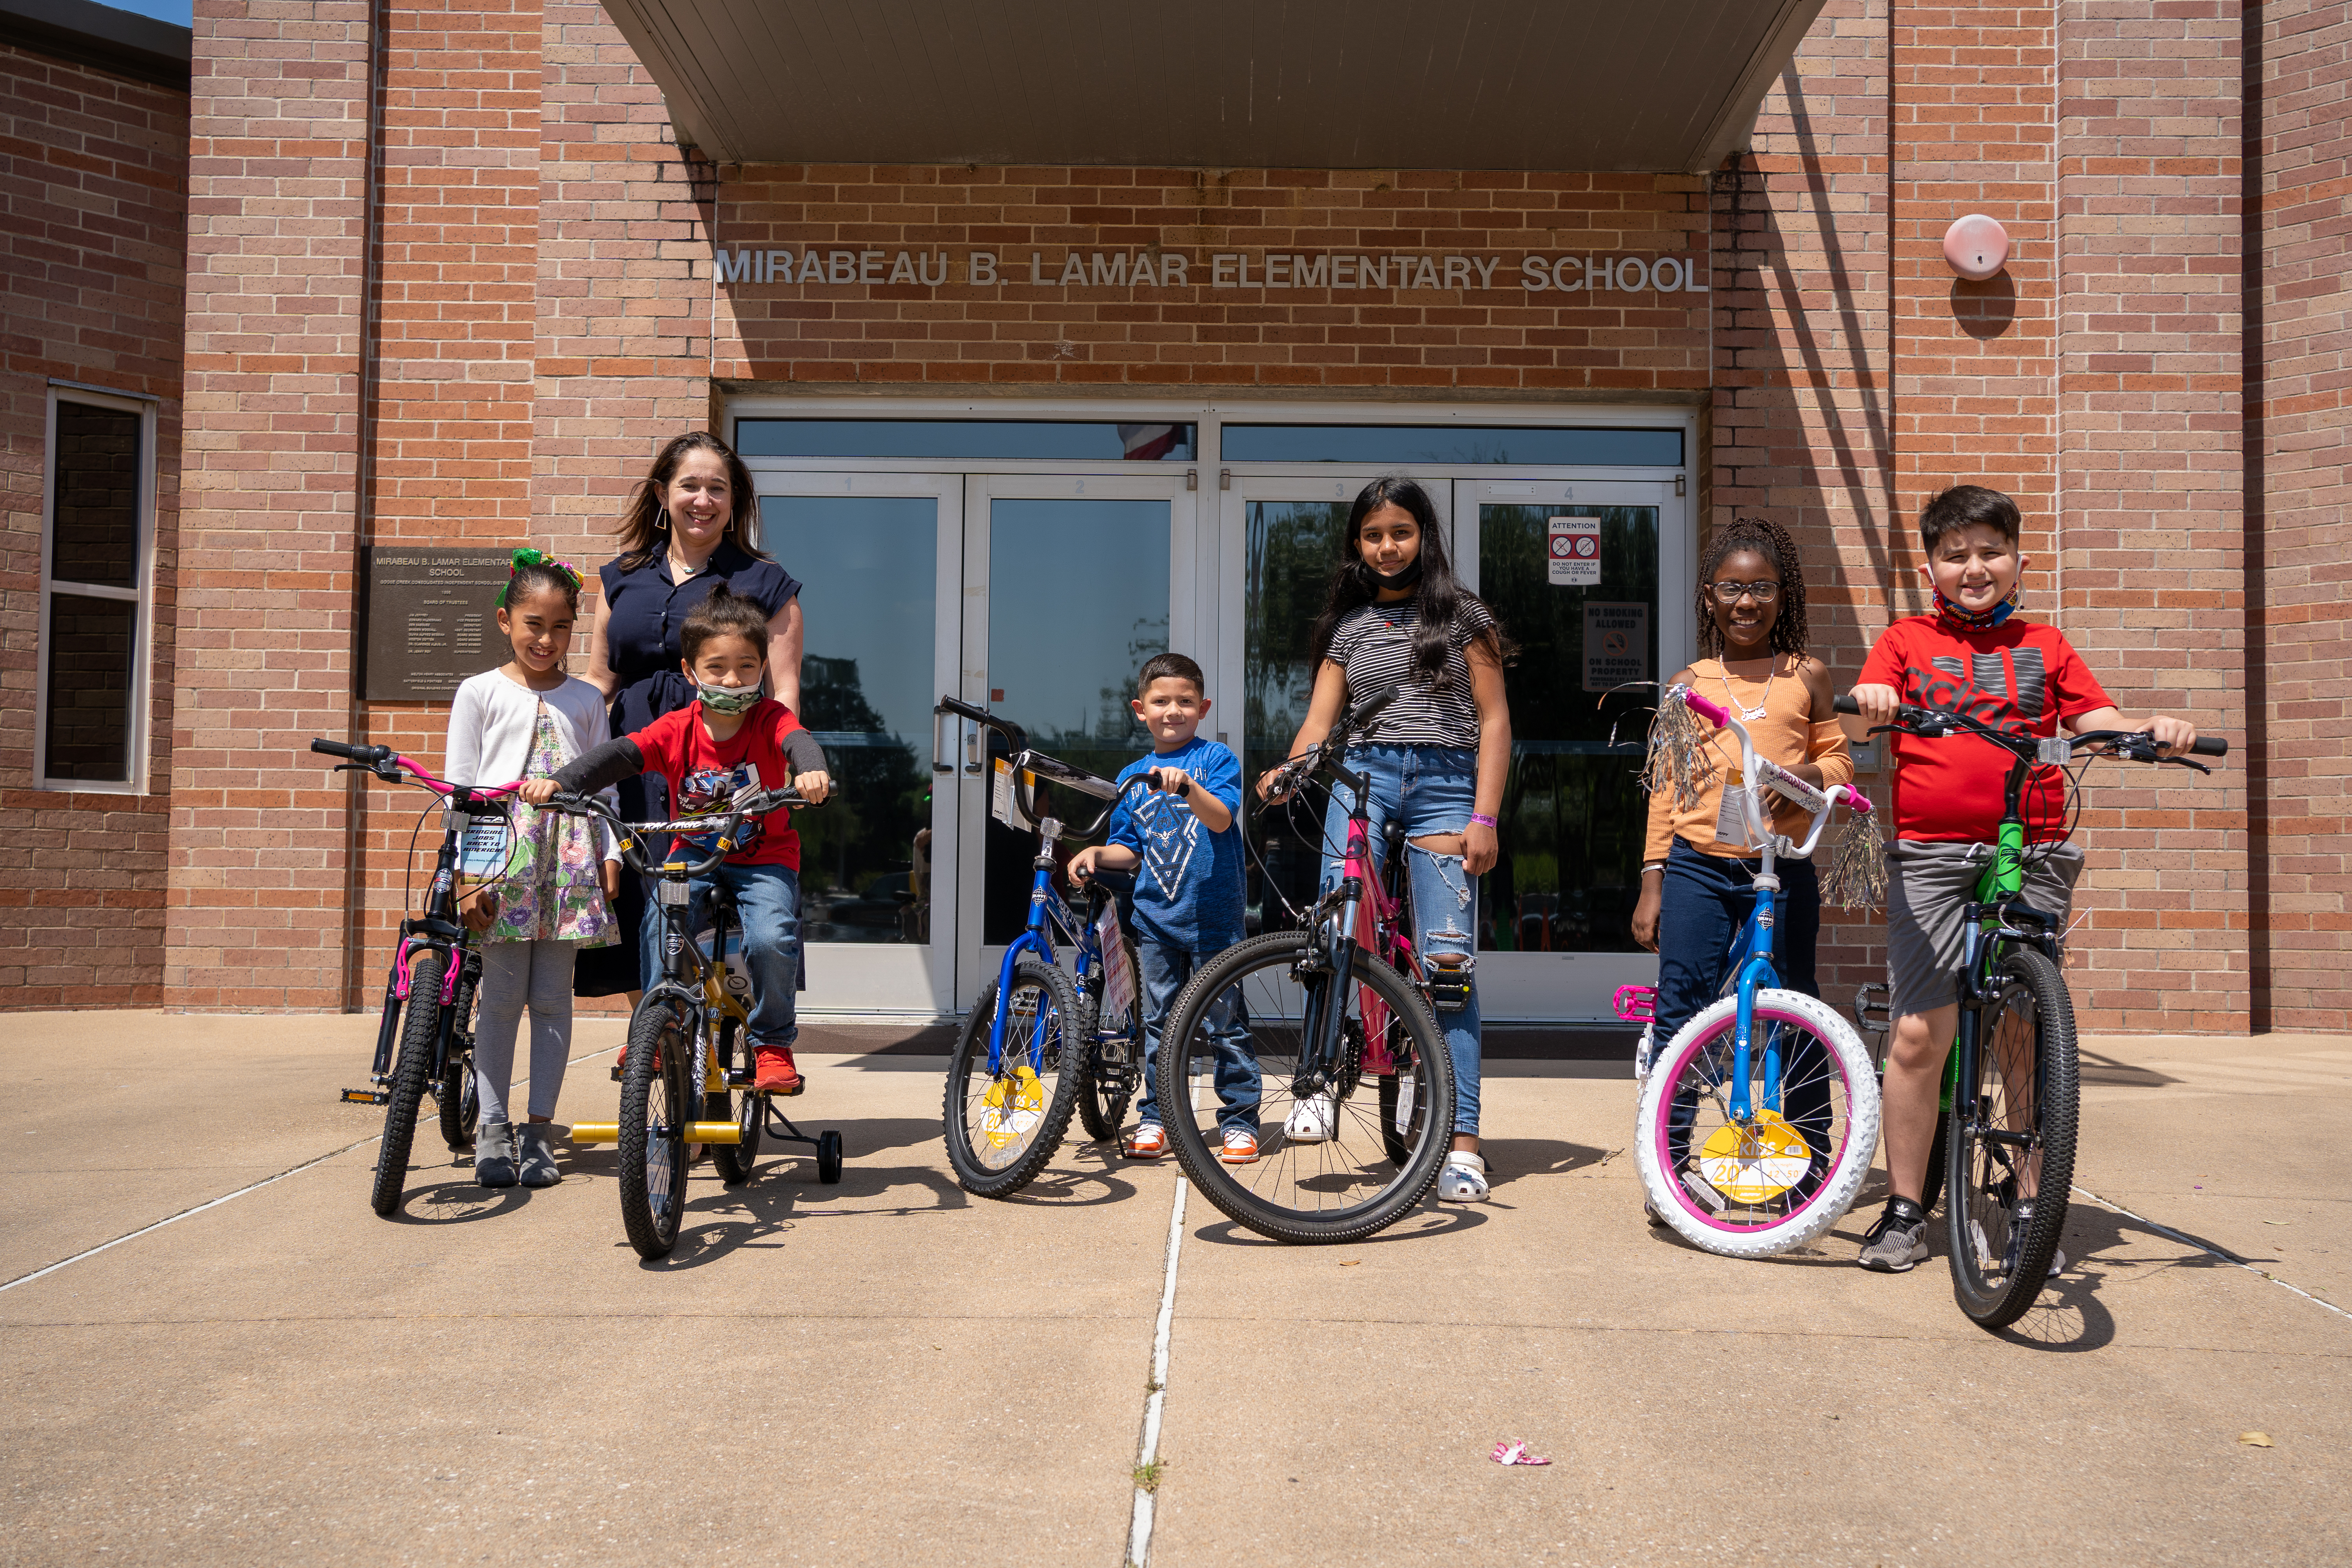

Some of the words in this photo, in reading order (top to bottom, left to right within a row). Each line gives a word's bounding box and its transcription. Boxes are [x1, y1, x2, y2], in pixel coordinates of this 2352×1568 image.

[716, 250, 947, 285] MIRABEAU
[970, 252, 1009, 286] B.
[1032, 252, 1189, 287] LAMAR
[1212, 254, 1500, 290] ELEMENTARY
[1521, 256, 1710, 292] SCHOOL
[844, 478, 851, 491] 1
[1075, 480, 1085, 494] 2
[1335, 484, 1344, 497] 3
[1564, 487, 1574, 500] 4
[430, 568, 465, 577] SCHOOL
[1589, 608, 1601, 617] NO
[1604, 608, 1643, 617] SMOKING
[1596, 619, 1636, 628] ALLOWED
[1906, 666, 2047, 766] adida
[1779, 766, 1810, 795] Seastar
[678, 793, 690, 803] ON
[679, 800, 696, 810] THE
[696, 1036, 707, 1101] RAMPAGE
[1005, 1094, 1027, 1107] KIDS
[1739, 1142, 1776, 1156] KIDS
[1713, 1164, 1750, 1183] 20"
